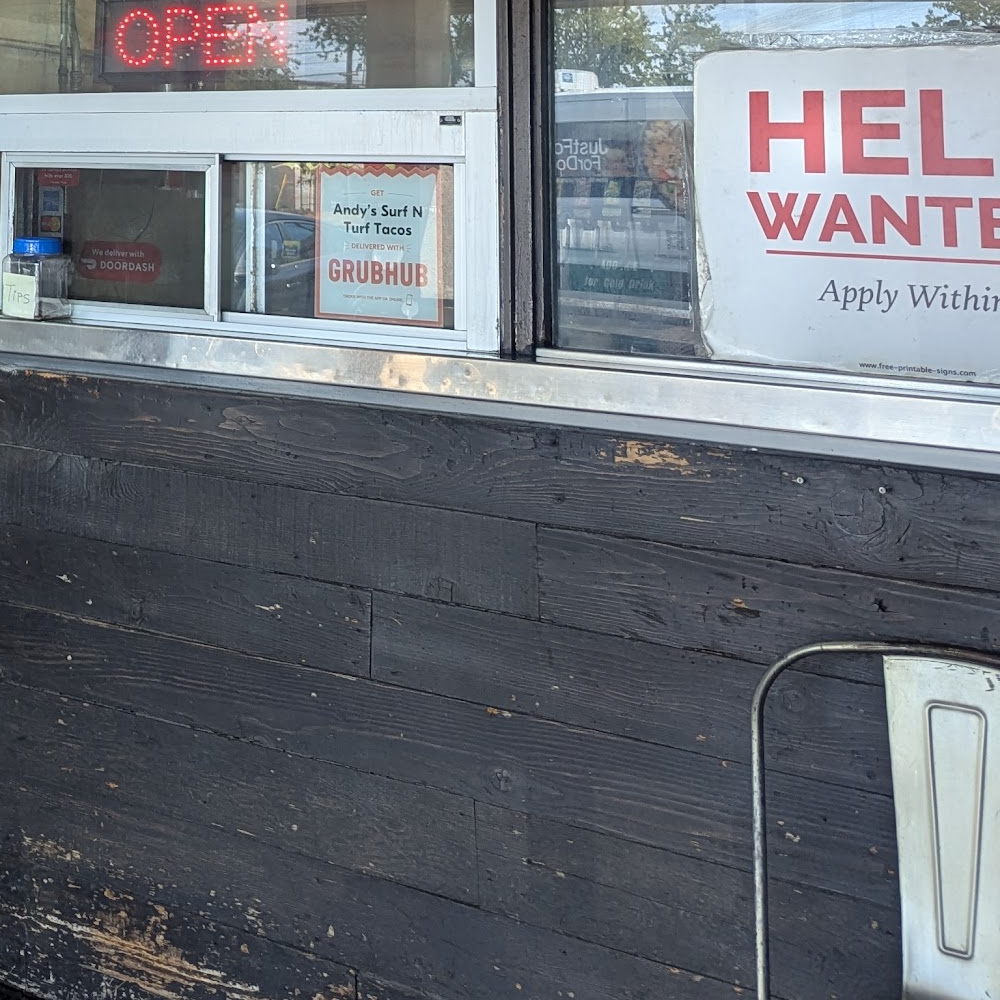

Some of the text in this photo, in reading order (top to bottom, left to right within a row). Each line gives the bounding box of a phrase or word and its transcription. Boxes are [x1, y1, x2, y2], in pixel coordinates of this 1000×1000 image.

[115, 1, 288, 67] OPEN
[749, 89, 994, 176] HEL
[333, 203, 423, 218] Andy's Surf N
[746, 191, 1000, 249] WANTE
[344, 221, 412, 236] Turf Tacos
[92, 248, 144, 258] We deliver with
[100, 260, 155, 272] DOORDASH
[328, 258, 428, 288] GRUBHUB
[818, 279, 899, 313] Apply
[858, 360, 977, 378] www.free-printable-signs.com
